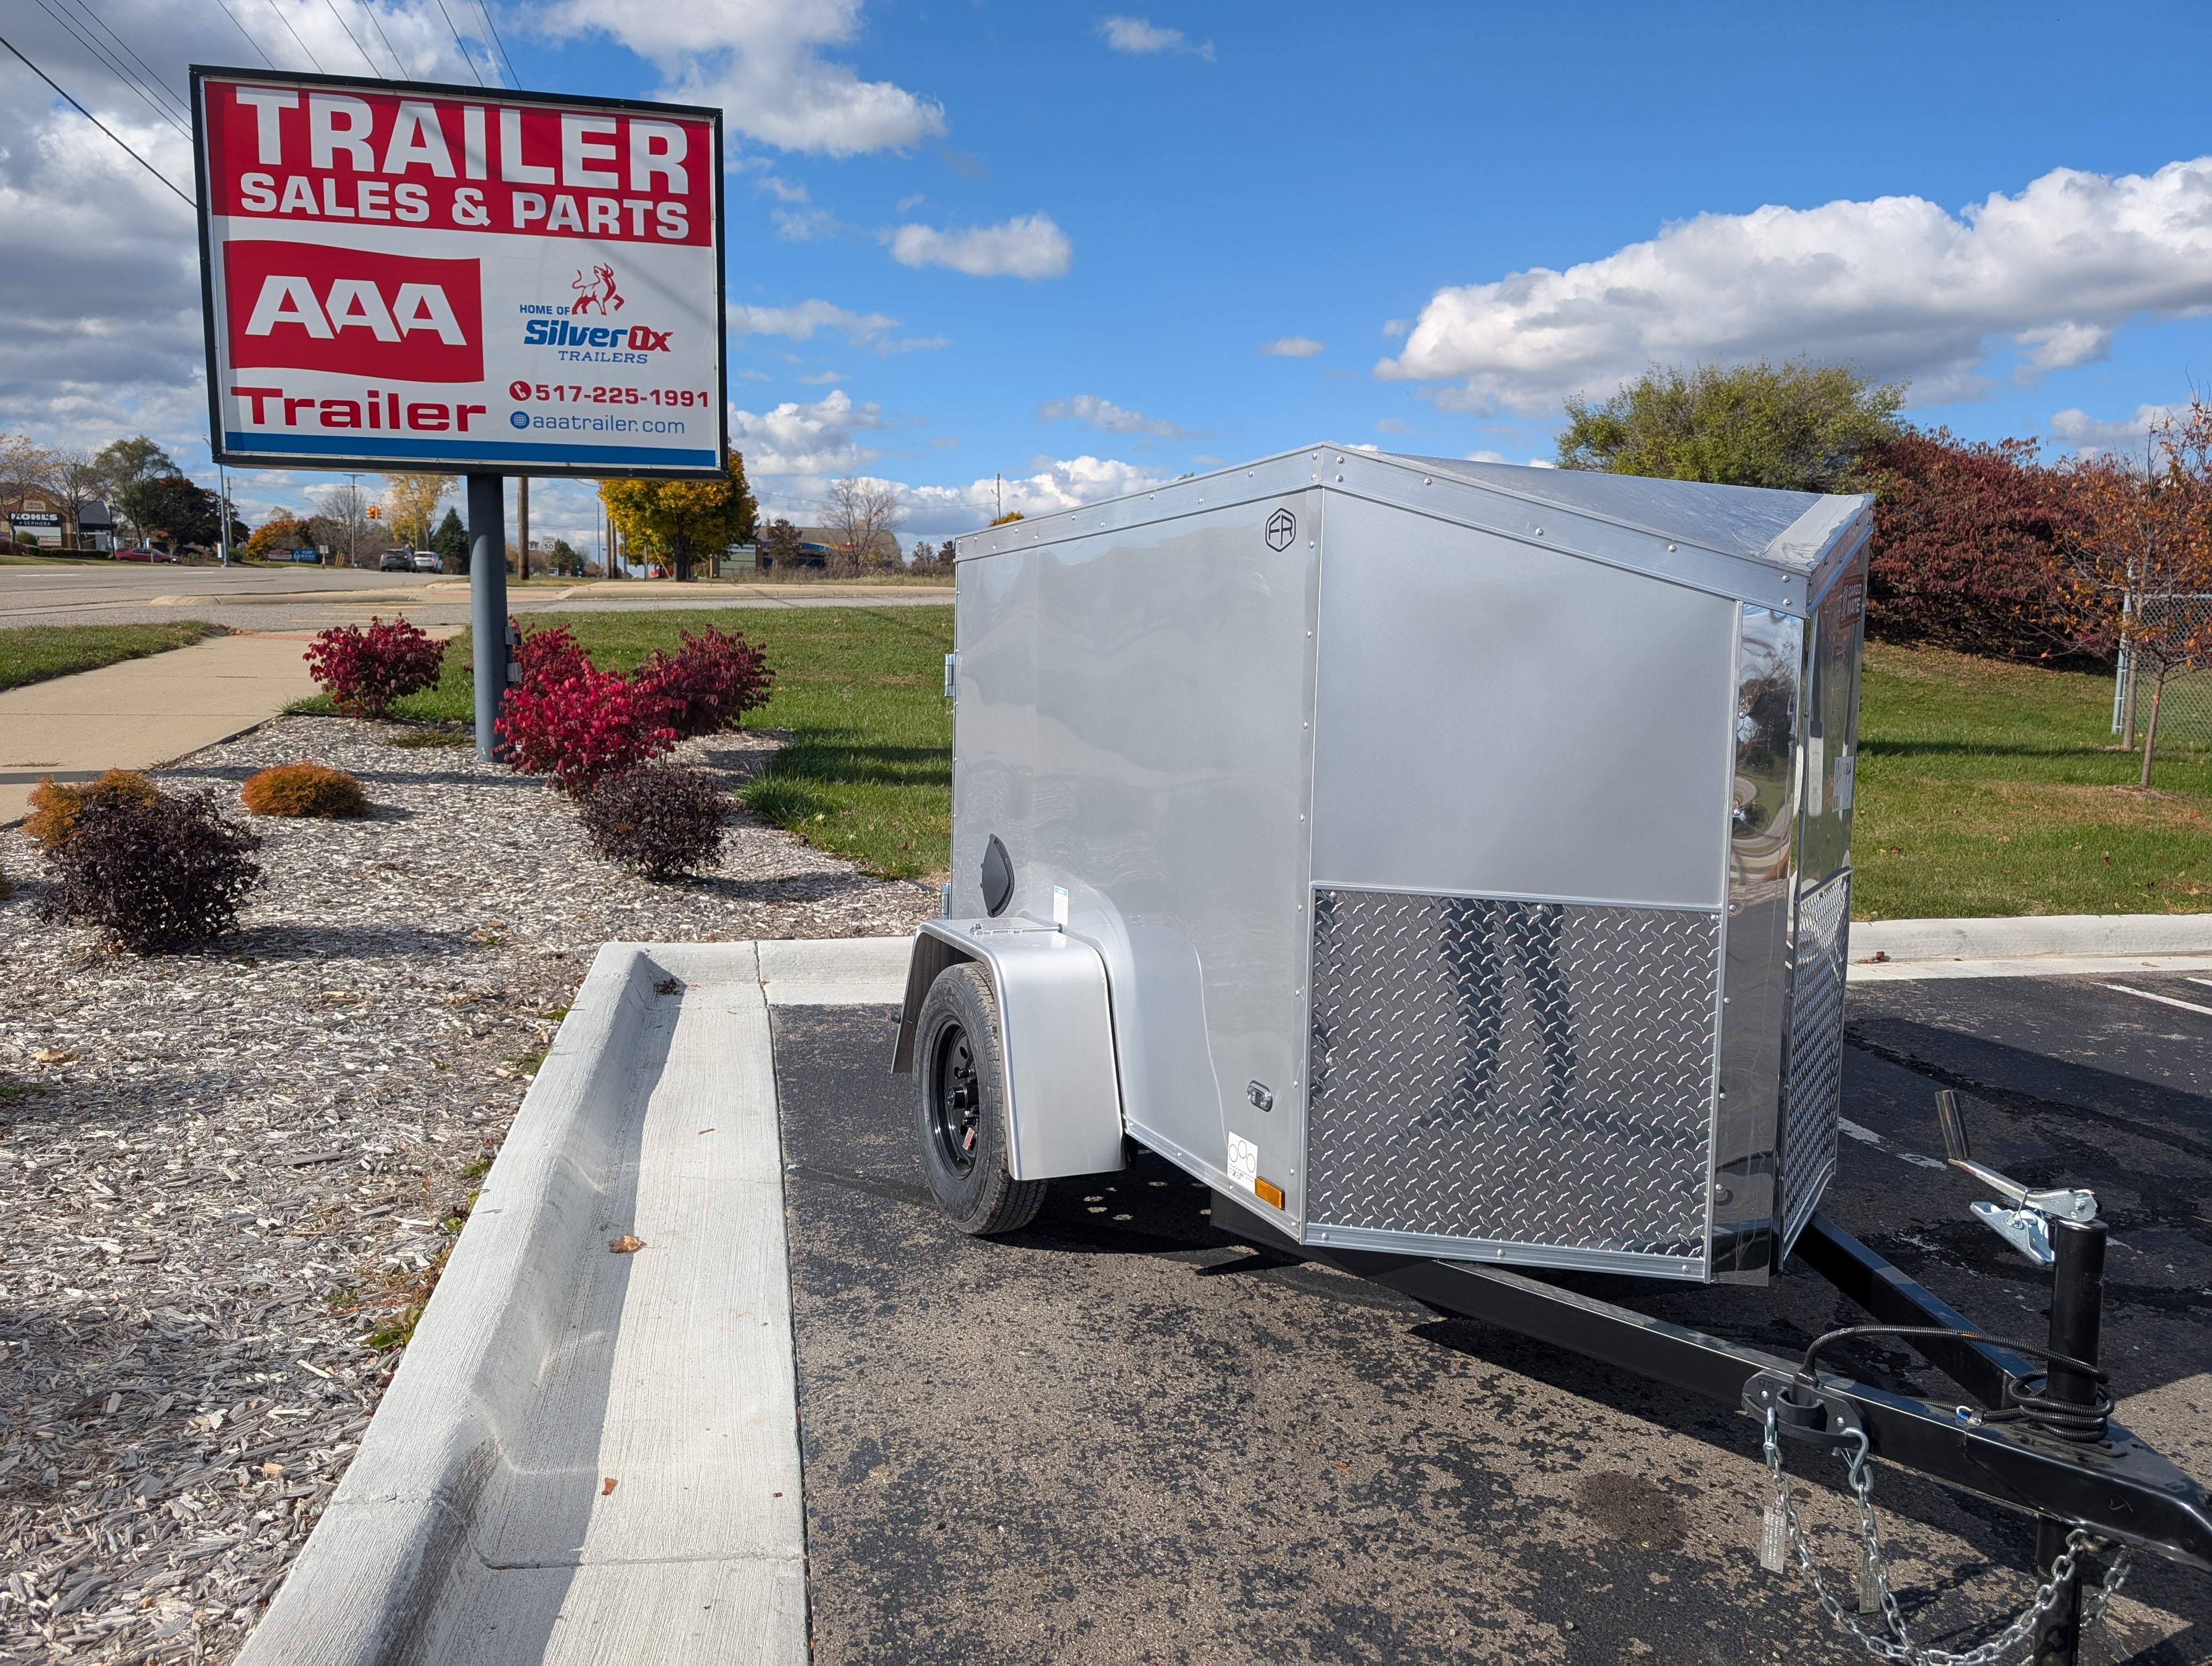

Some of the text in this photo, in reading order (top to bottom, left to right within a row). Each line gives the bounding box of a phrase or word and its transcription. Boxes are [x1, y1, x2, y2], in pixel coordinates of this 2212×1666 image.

[236, 86, 689, 195] TRAILER
[240, 172, 689, 239] SALES & PARTS
[245, 275, 467, 345] AAA
[519, 304, 570, 316] HOME OF
[558, 350, 648, 364] TRAILERS
[536, 384, 708, 407] 517-225-1991
[231, 387, 486, 432] Trailer
[532, 415, 685, 434] aaatrailer.com
[1846, 597, 1861, 616] MATE
